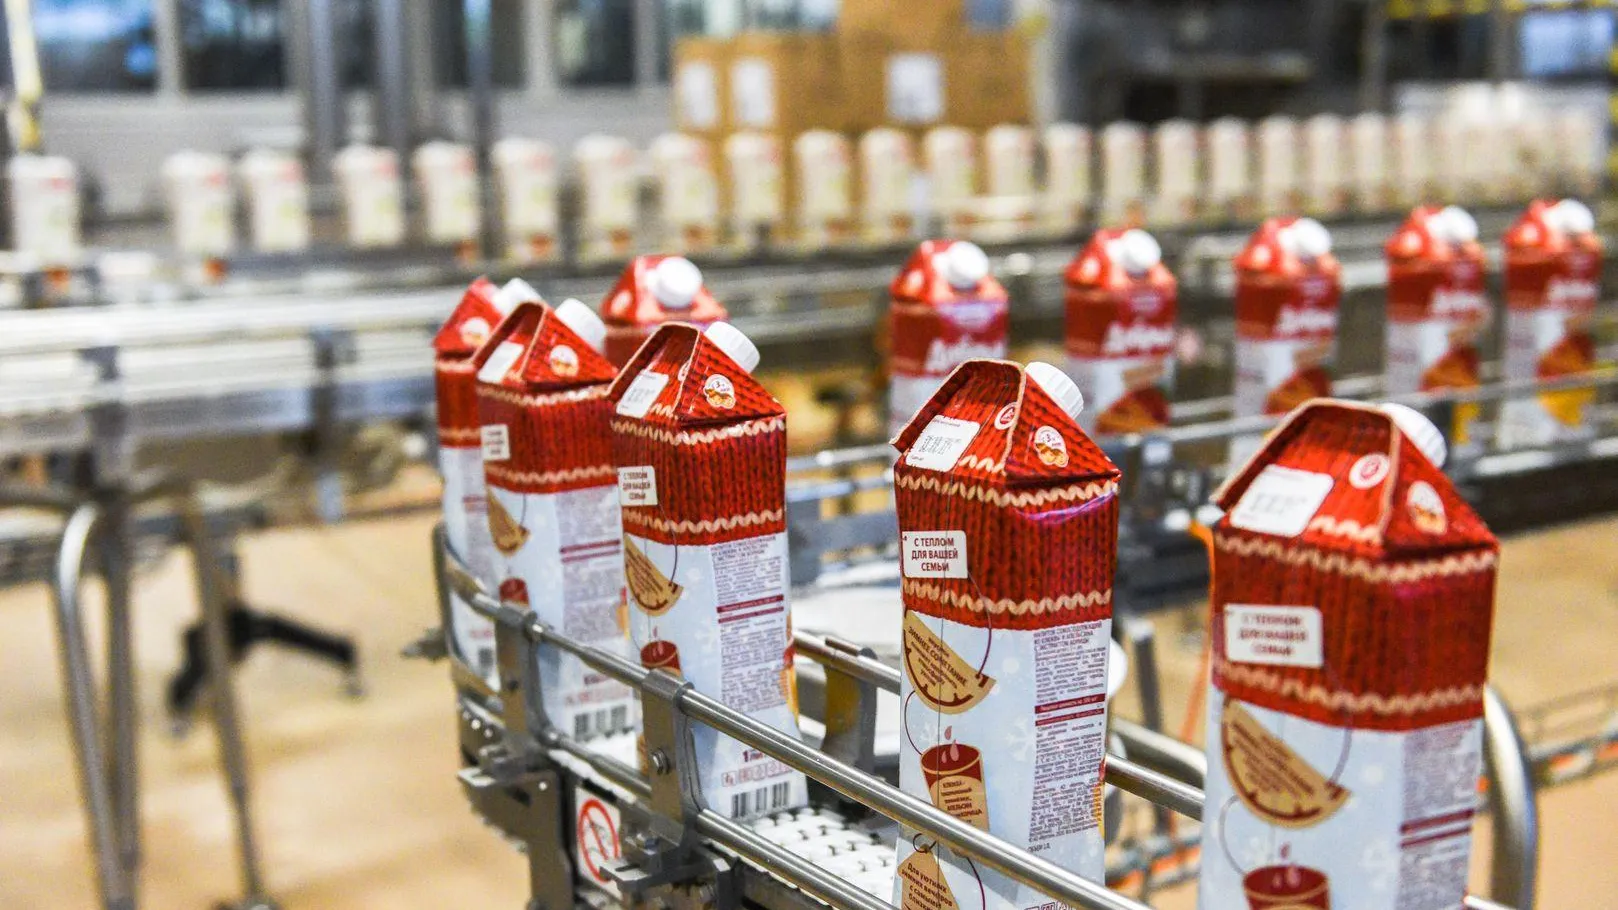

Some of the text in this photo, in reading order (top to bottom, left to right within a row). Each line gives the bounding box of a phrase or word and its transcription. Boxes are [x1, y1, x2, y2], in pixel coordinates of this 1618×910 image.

[914, 537, 954, 547] С ТЕПЛОМ
[911, 548, 958, 560] ДЛЯ ВАШЕЙ
[921, 563, 949, 572] СЕМЬИ
[908, 626, 931, 653] ЗИМНЕЕ
[930, 650, 968, 686] СОЧЕТАНИЕ
[902, 869, 952, 906] зимних вечеров
[908, 863, 947, 893] Для уютных
